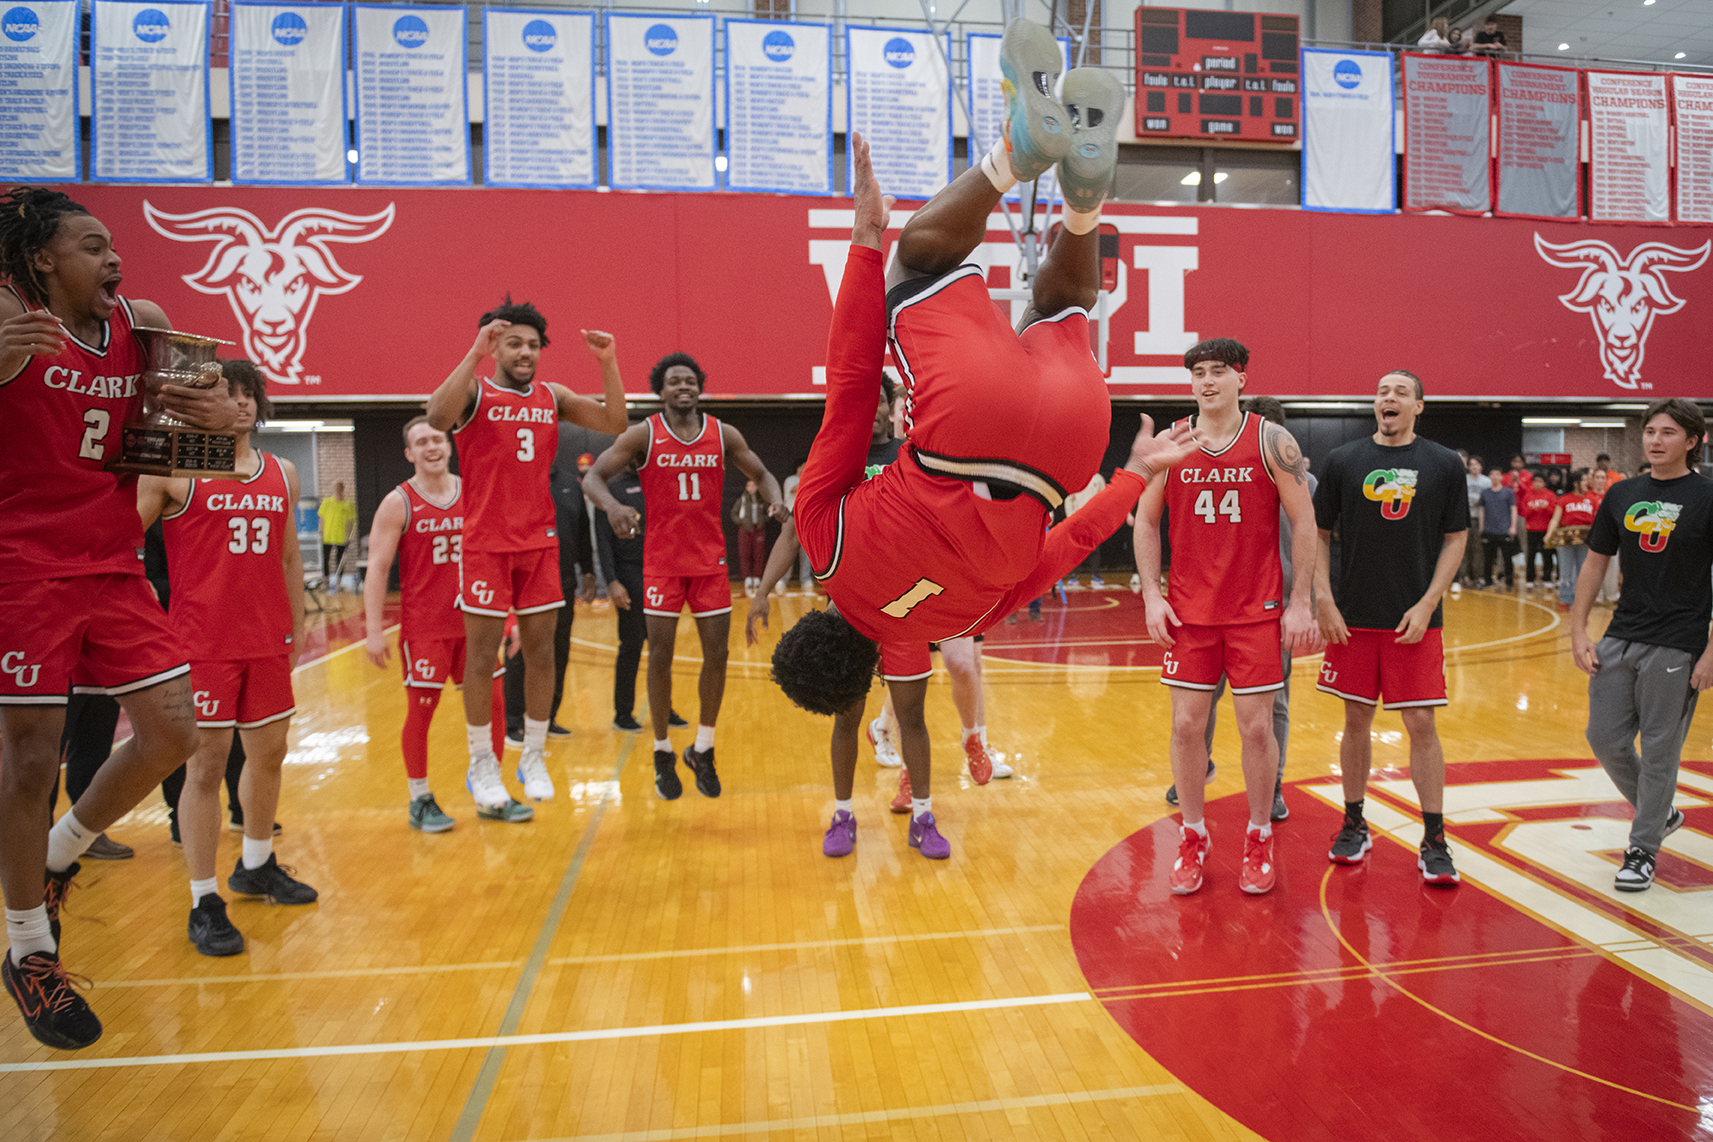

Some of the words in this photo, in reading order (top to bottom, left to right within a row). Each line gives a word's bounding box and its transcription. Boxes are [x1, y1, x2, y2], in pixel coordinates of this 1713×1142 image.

[5, 23, 38, 33] NCAA
[1205, 57, 1236, 69] period
[1144, 73, 1168, 86] fouls
[1204, 76, 1236, 90] player
[1272, 80, 1296, 92] fouls
[1409, 80, 1487, 96] CHAMPIONS
[1600, 78, 1653, 88] CONFERENCE
[1503, 88, 1577, 104] CHAMPIONS
[1593, 96, 1665, 109] CHAMPIONS
[1146, 119, 1167, 129] won
[1208, 122, 1233, 133] game
[1274, 125, 1294, 135] won
[43, 365, 141, 399] CLARK
[487, 406, 554, 425] CLARK
[79, 408, 110, 461] 2
[516, 428, 535, 463] 3
[656, 453, 719, 468] CLARK
[1180, 467, 1254, 484] CLARK
[678, 472, 702, 501] 11
[1363, 468, 1416, 521] CU
[206, 493, 285, 513] CLARK
[1194, 489, 1242, 524] 44
[416, 517, 463, 533] CLAR
[1624, 501, 1678, 553] CU
[228, 517, 271, 554] 33
[432, 534, 463, 565] 23
[471, 580, 495, 605] CU
[646, 586, 664, 607] CU
[879, 576, 946, 618] 1
[1, 650, 41, 687] CU
[415, 659, 435, 679] CU
[1163, 651, 1179, 675] CU
[1320, 661, 1338, 683] CU
[193, 690, 220, 716] CU
